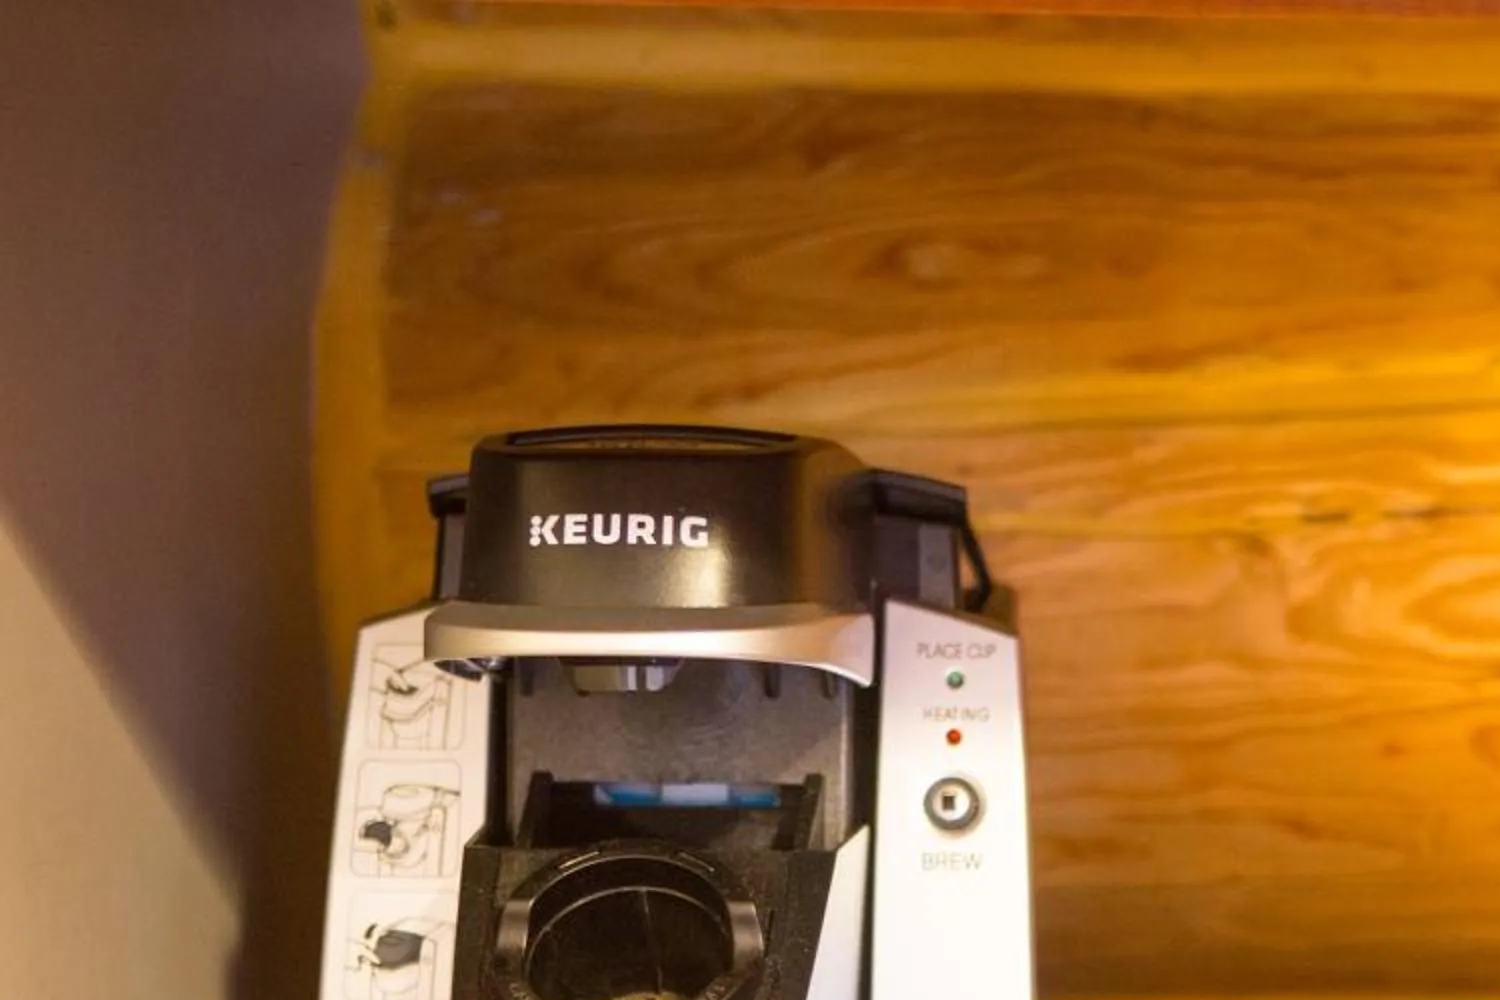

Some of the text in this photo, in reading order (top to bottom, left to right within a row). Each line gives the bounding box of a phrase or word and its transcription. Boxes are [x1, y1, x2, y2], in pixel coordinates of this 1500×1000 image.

[529, 513, 709, 547] KEURIG
[916, 642, 997, 659] PLACE CUP
[923, 707, 990, 722] HEATING
[922, 853, 981, 870] BREW
